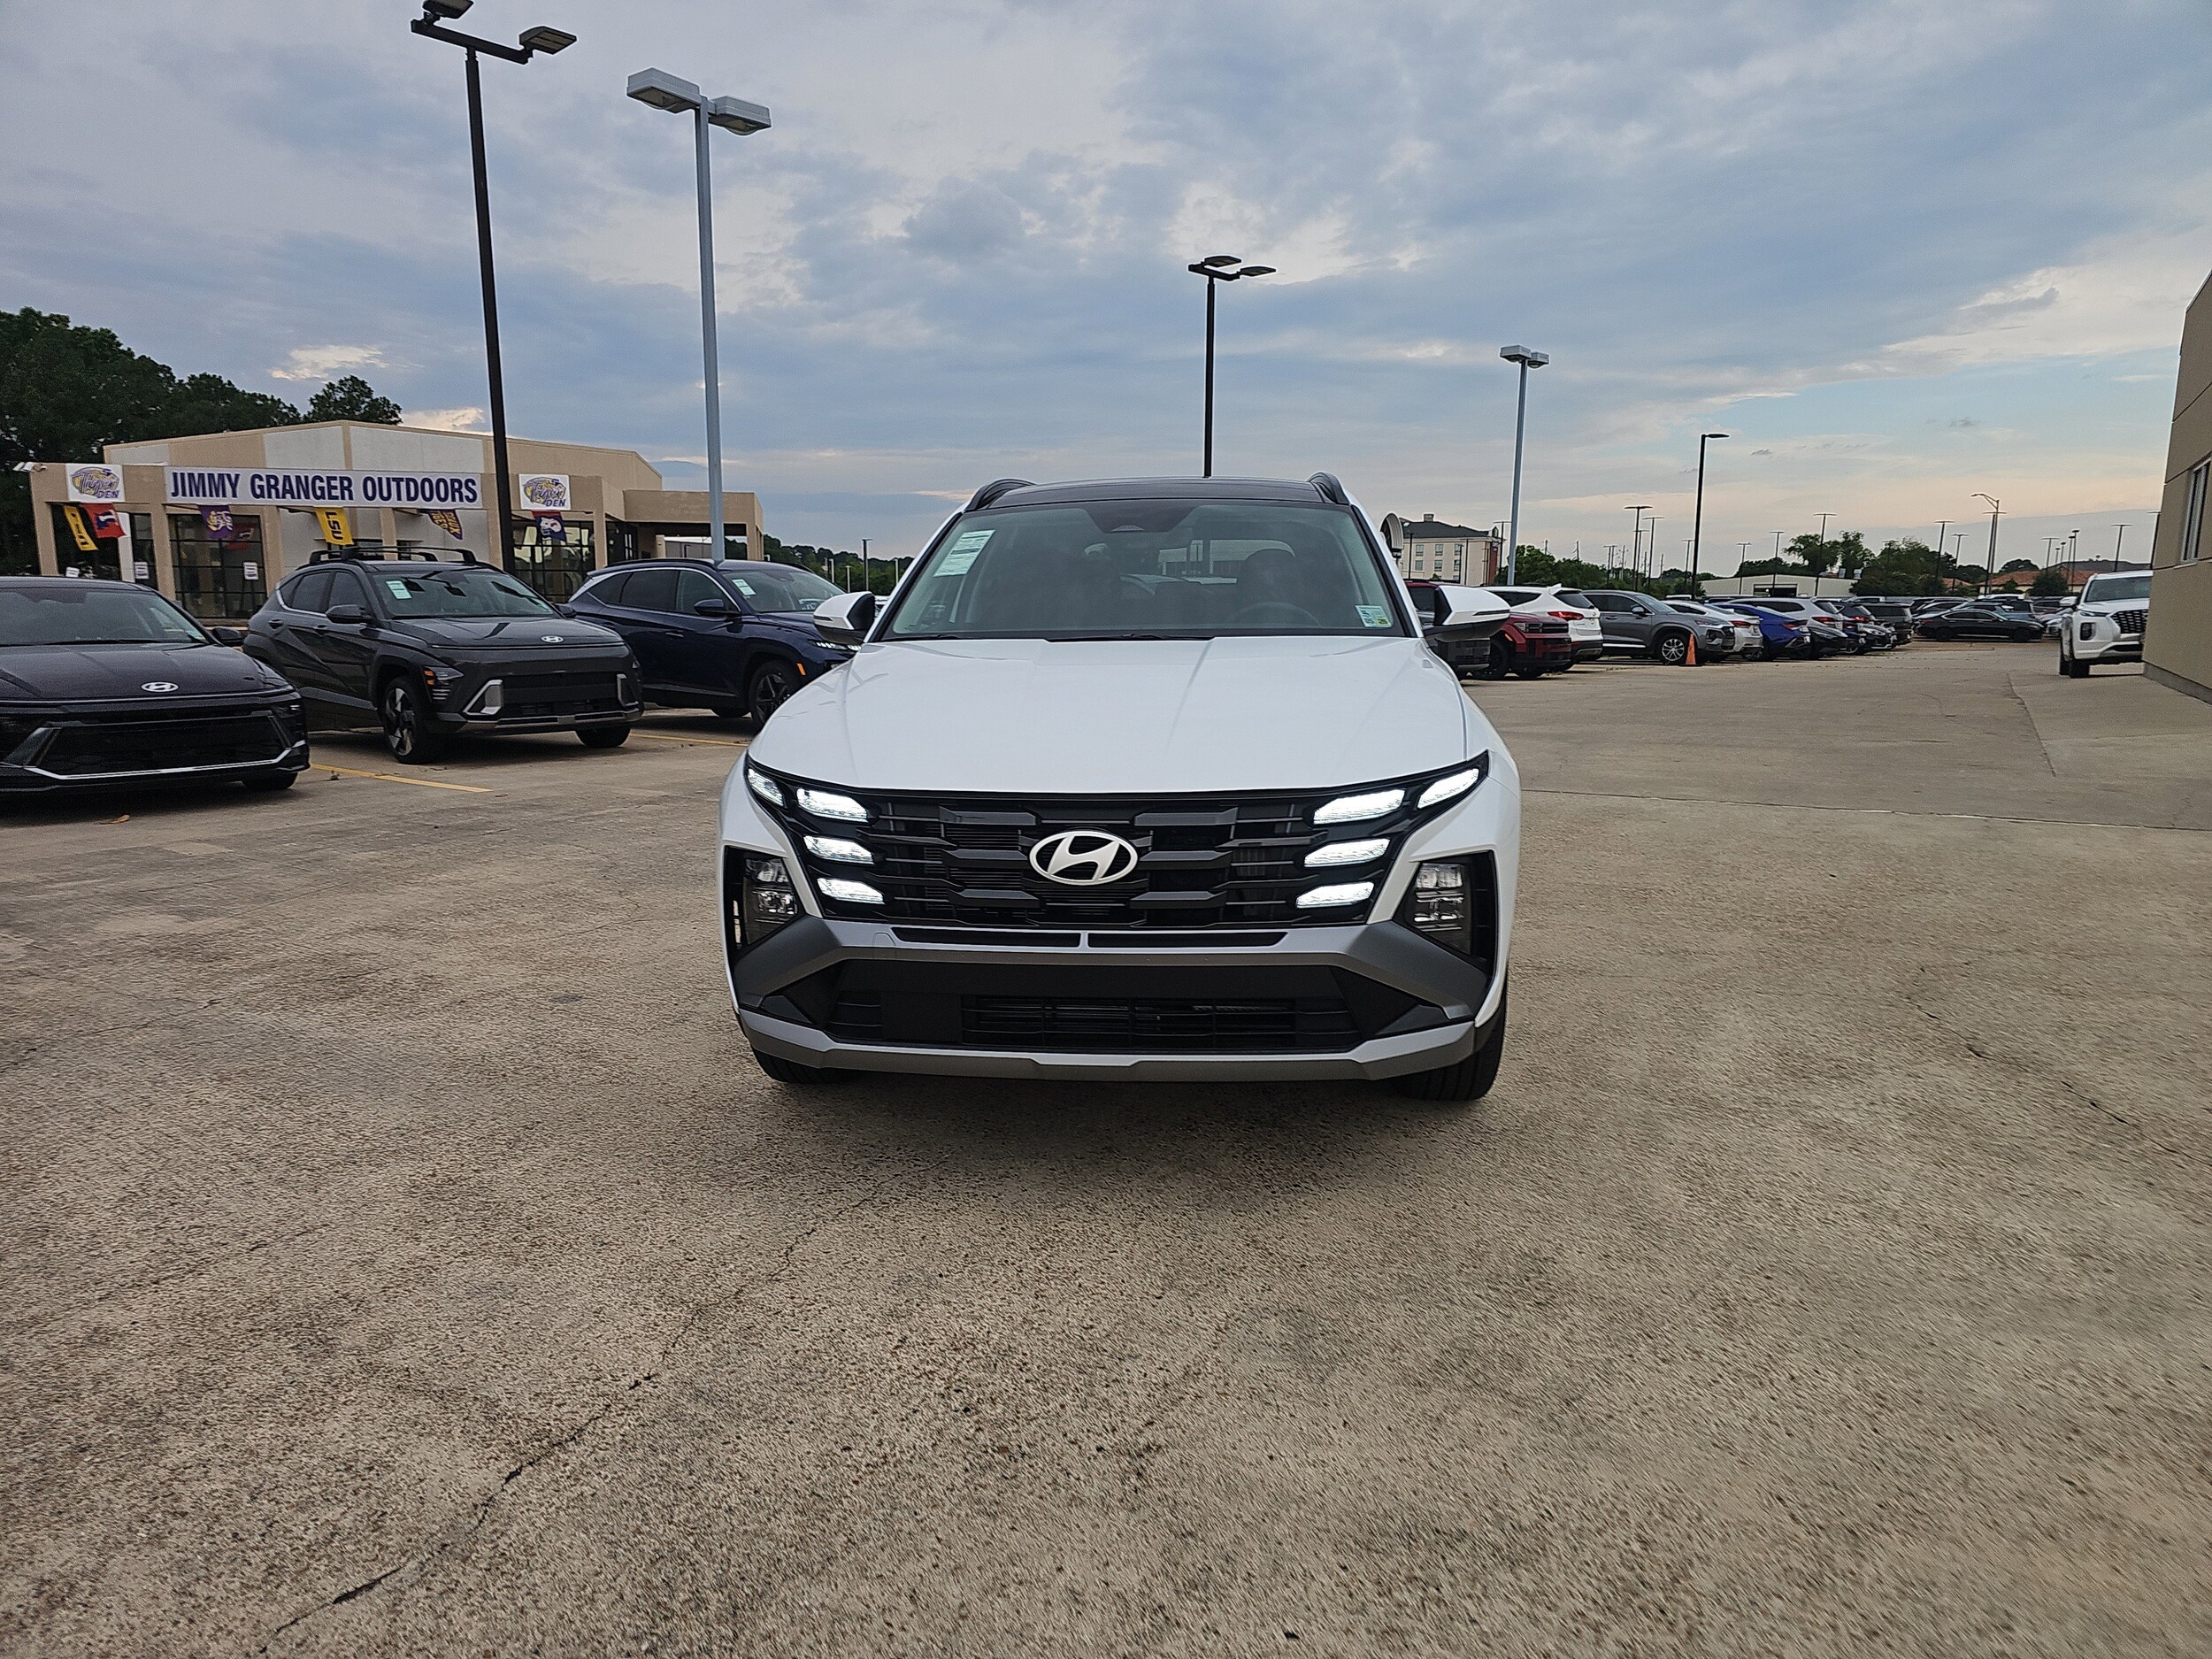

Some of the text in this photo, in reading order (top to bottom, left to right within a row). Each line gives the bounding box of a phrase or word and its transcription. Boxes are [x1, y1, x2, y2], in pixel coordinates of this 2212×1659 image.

[96, 490, 119, 499] DEN
[171, 472, 478, 503] JIMMY GRANGER OUTDOORS
[325, 511, 344, 541] LSU
